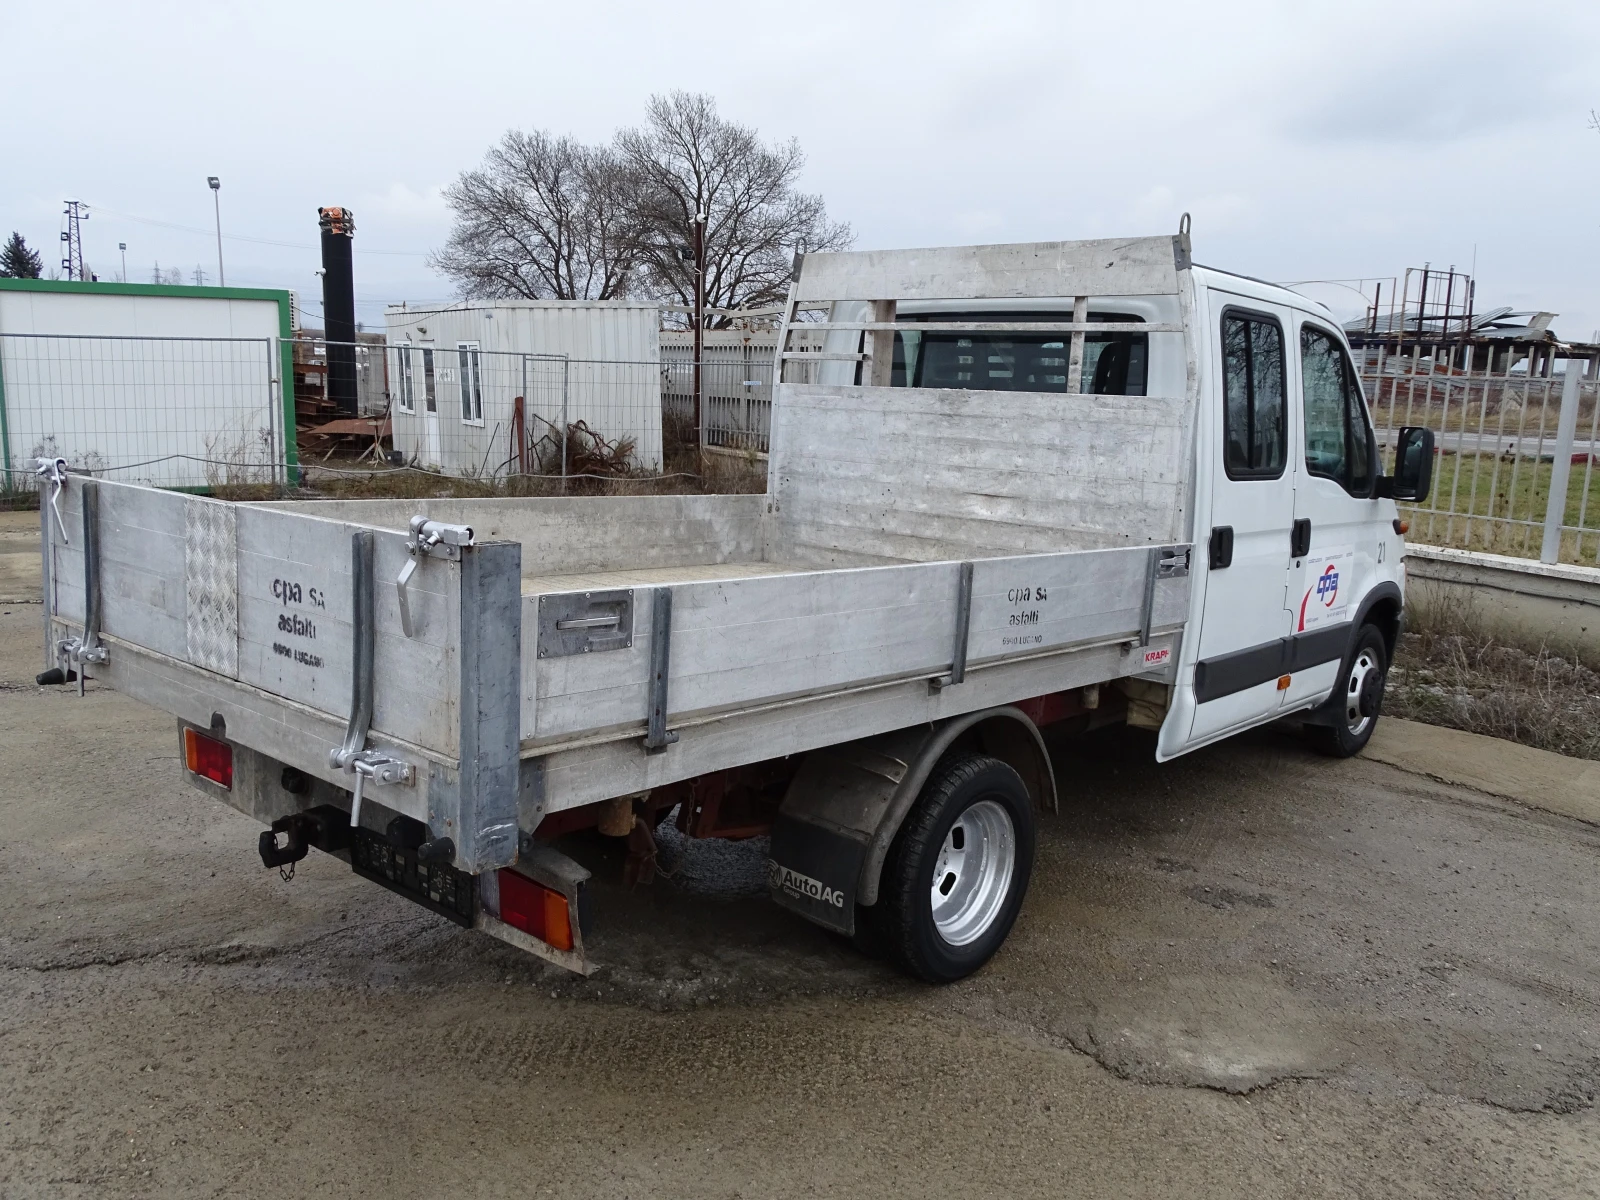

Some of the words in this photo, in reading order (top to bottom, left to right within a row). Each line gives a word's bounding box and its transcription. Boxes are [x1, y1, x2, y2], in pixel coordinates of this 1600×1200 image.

[1378, 541, 1386, 564] 21
[272, 578, 302, 606] cpa
[1007, 586, 1031, 606] cpa
